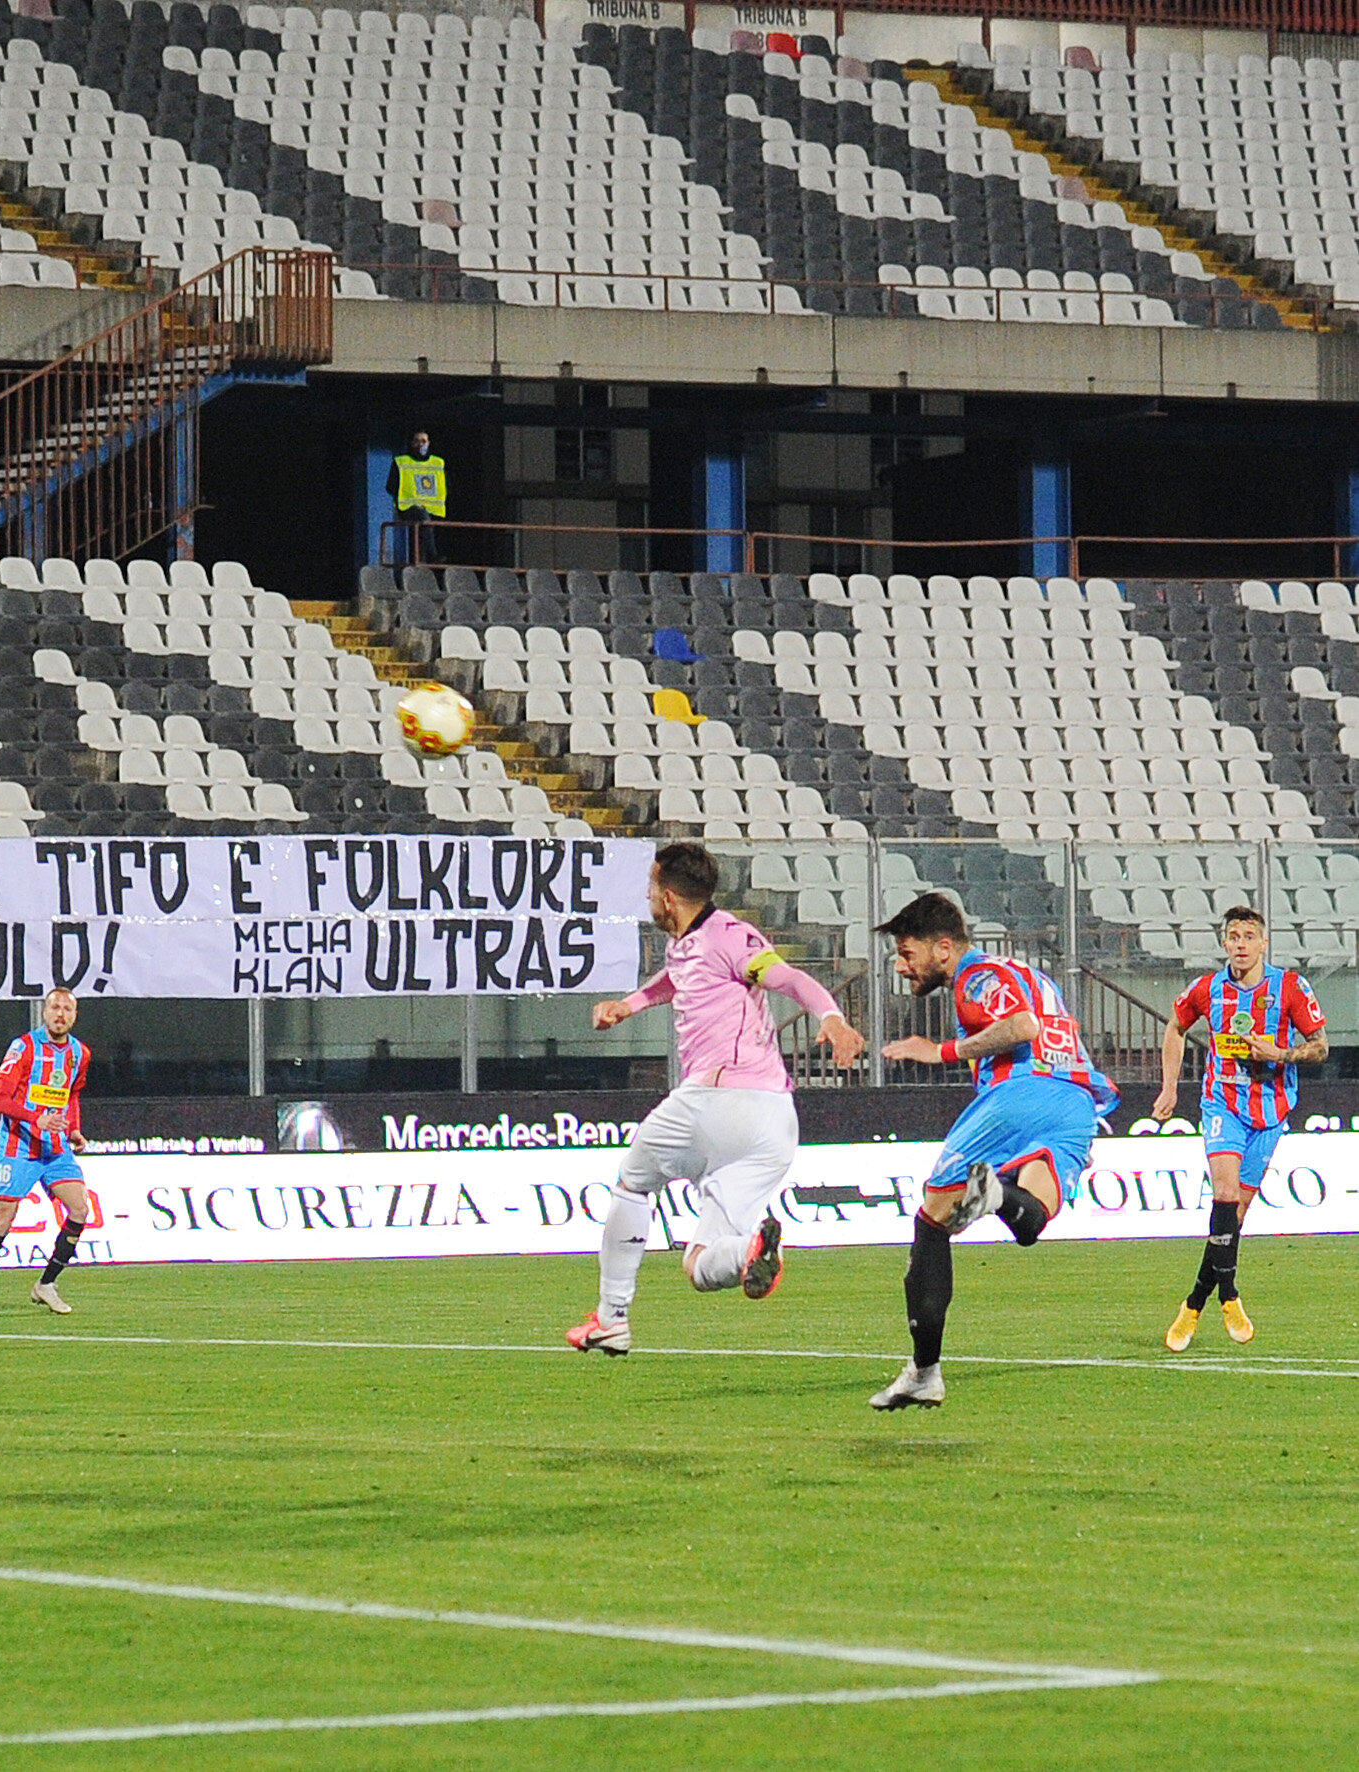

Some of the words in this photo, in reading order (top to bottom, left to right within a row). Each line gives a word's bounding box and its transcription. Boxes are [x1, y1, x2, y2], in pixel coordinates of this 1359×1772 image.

[587, 1, 647, 19] TRIBUNA
[651, 4, 660, 19] B
[735, 8, 791, 26] TRIBUNA
[798, 11, 807, 26] B
[36, 840, 189, 915] TIFO
[229, 840, 262, 914] E
[304, 839, 605, 913] FOLKLORE
[233, 919, 353, 954] MECHA
[364, 917, 597, 994] ULTRAS
[233, 956, 344, 994] KLAN
[211, 1134, 265, 1153] Vendita
[382, 1112, 640, 1151] Mercedes-Benz
[1210, 1115, 1223, 1137] 8
[146, 1184, 489, 1232] SICUREZZA
